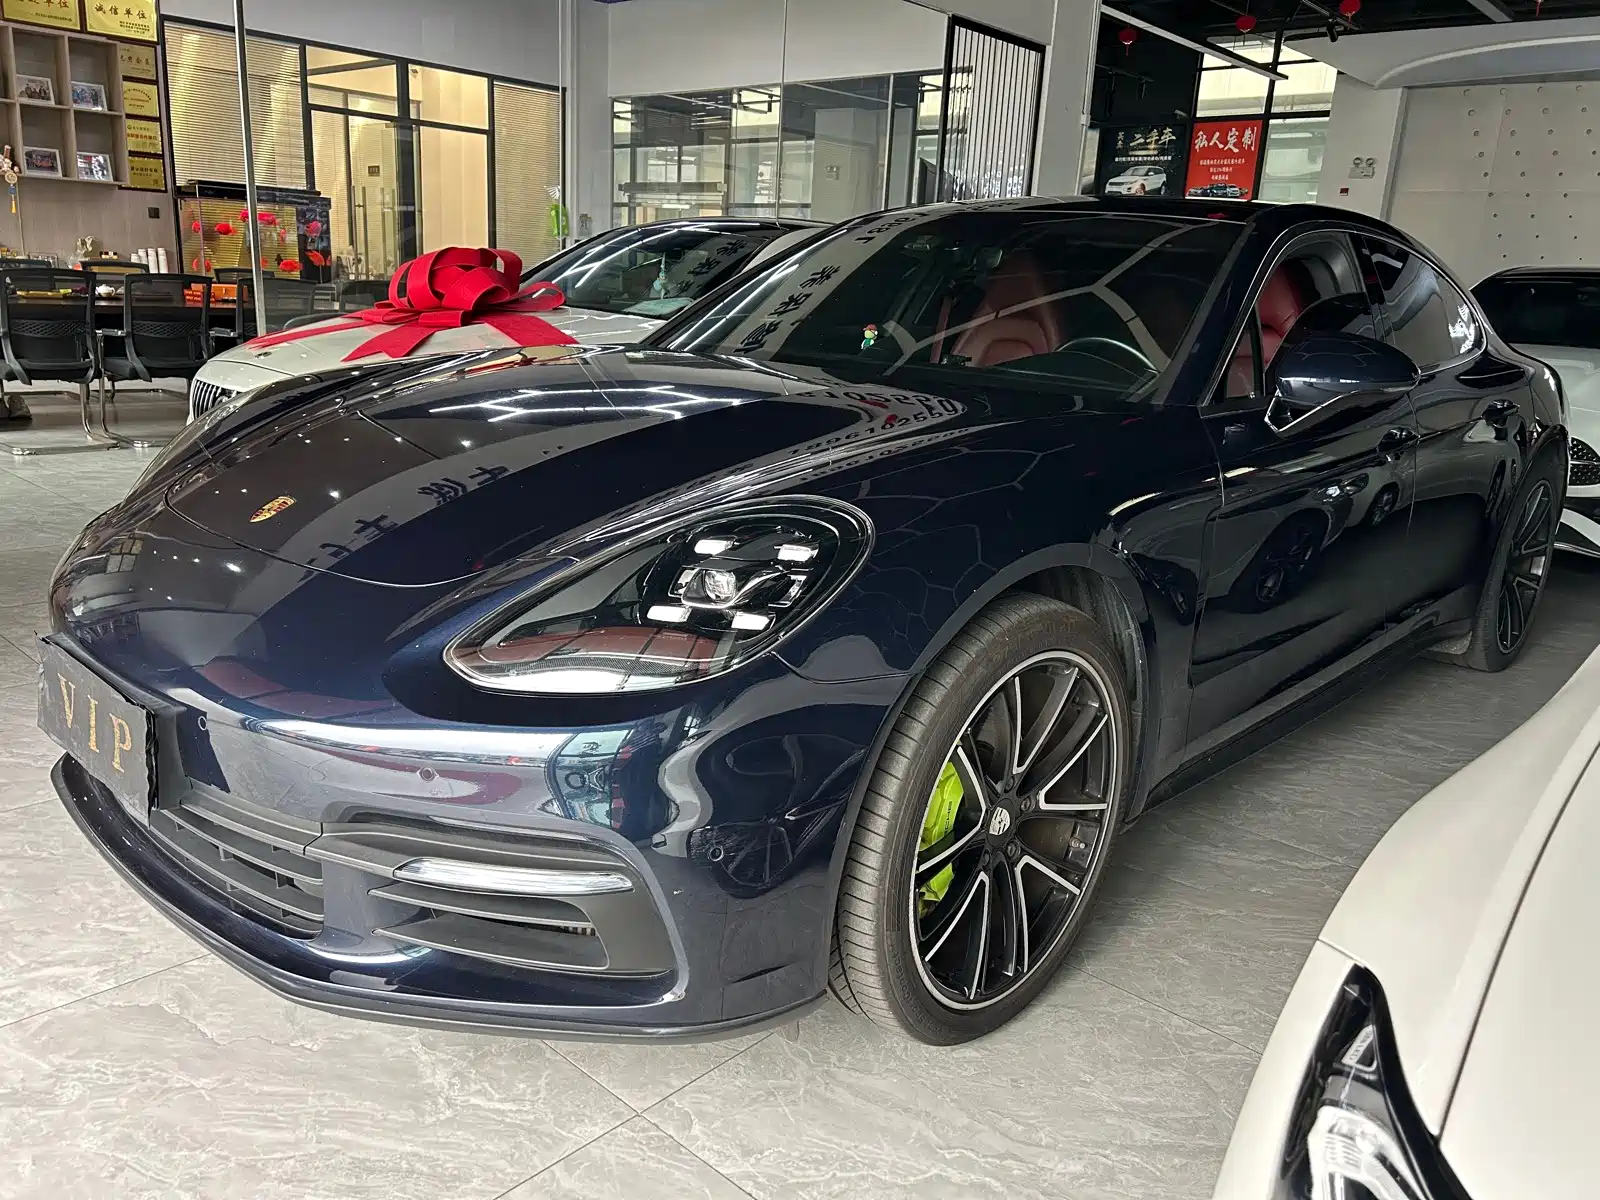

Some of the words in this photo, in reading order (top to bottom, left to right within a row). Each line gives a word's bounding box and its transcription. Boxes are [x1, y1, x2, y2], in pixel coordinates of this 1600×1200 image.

[94, 2, 148, 20] 诚信单位
[1129, 127, 1177, 149] 二手车
[1194, 126, 1257, 153] 私人定制
[57, 672, 133, 774] VIP
